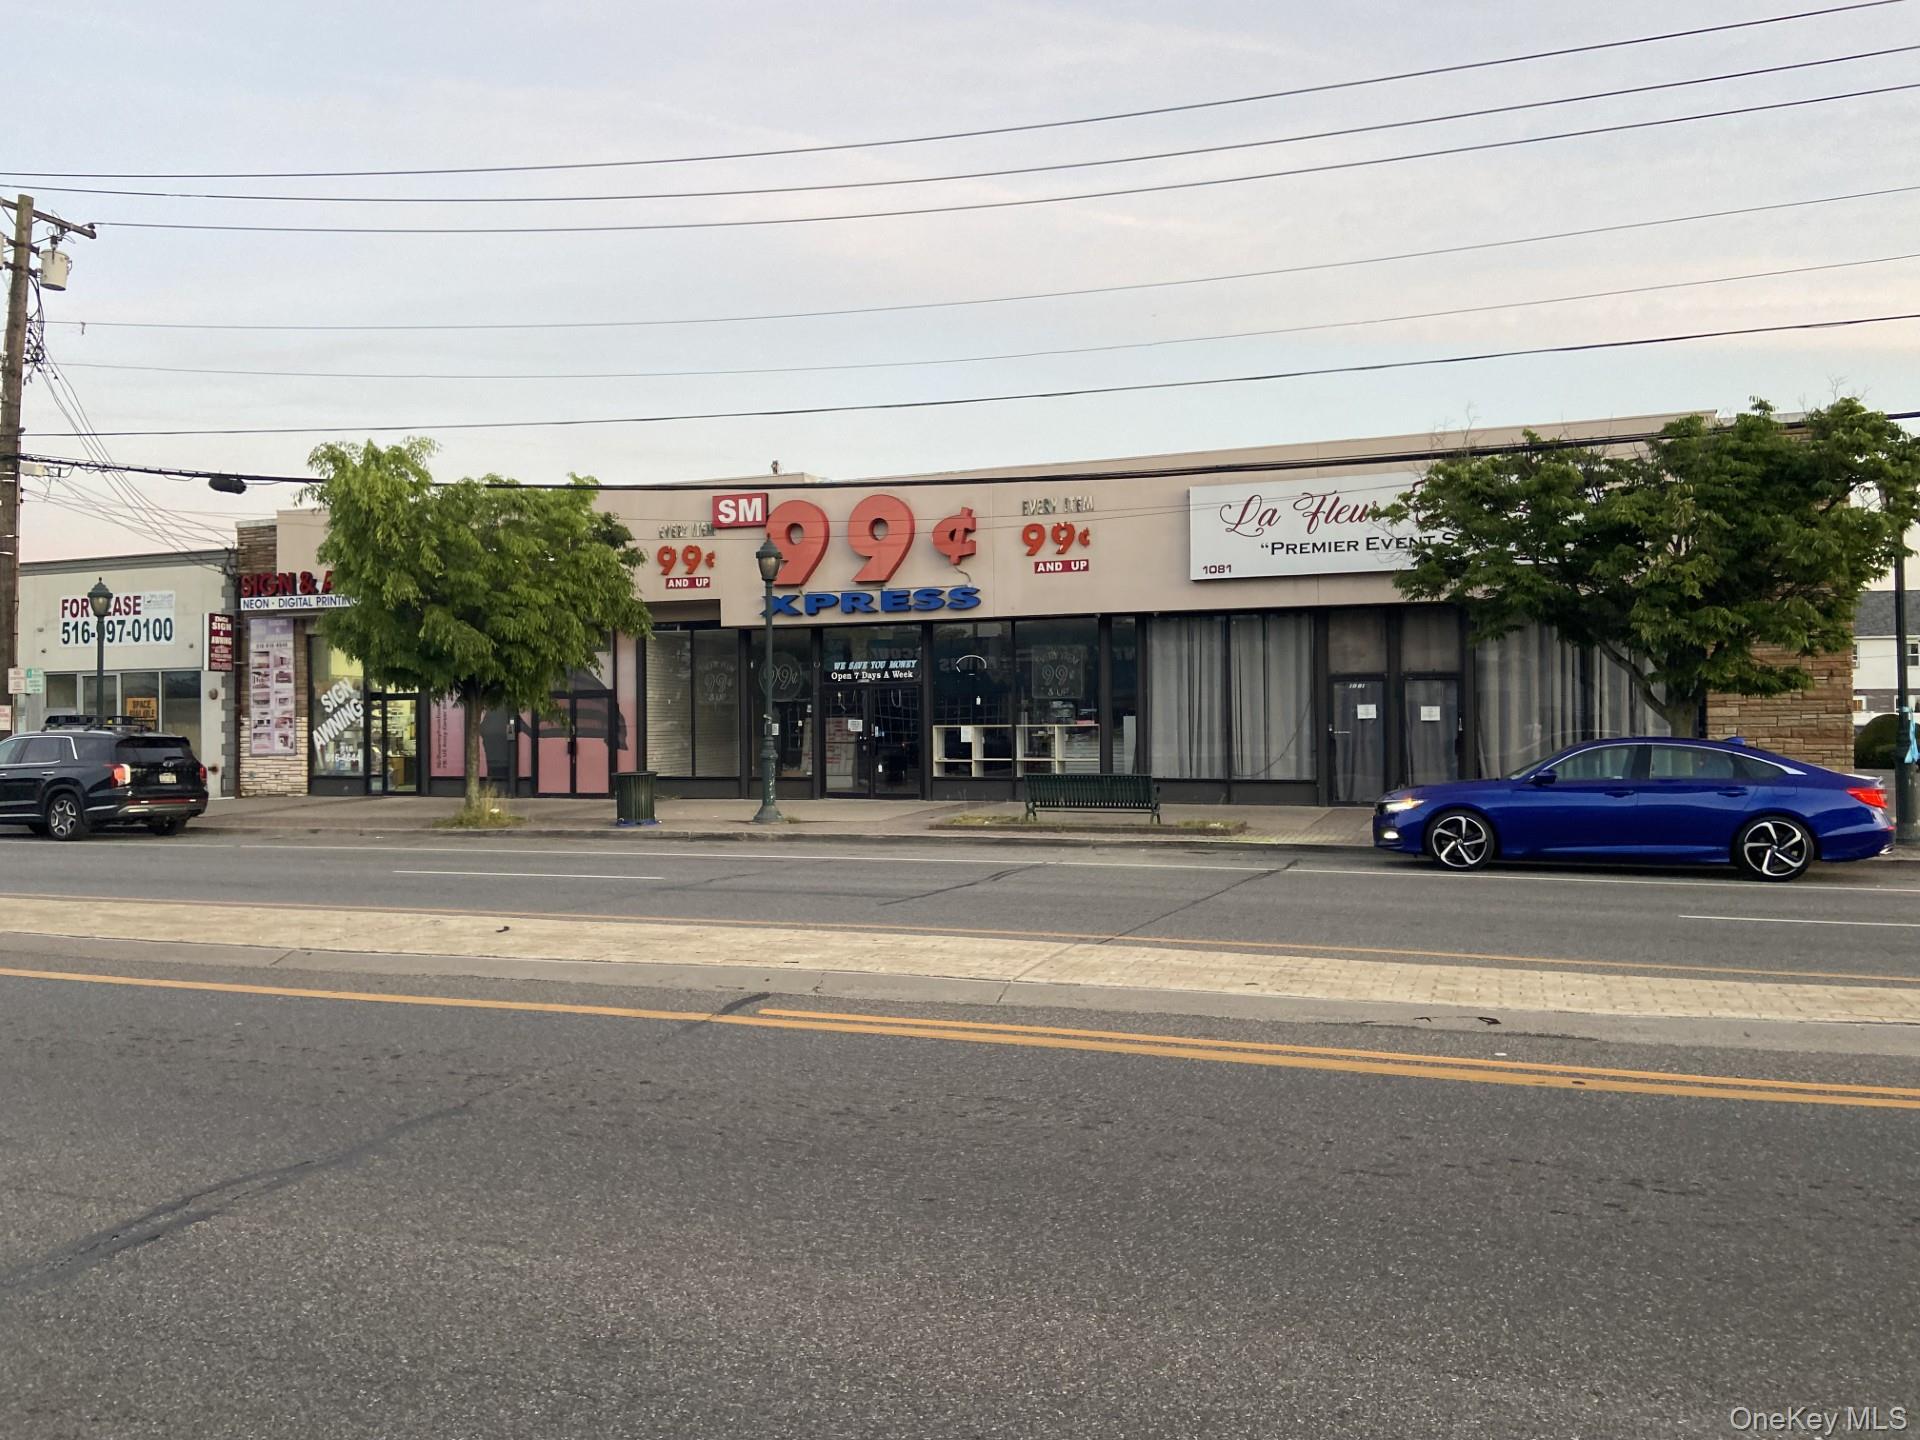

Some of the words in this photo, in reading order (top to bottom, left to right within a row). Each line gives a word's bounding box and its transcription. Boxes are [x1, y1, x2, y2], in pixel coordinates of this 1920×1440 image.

[717, 497, 762, 524] SM
[1022, 497, 1057, 516] EVERY
[1064, 495, 1094, 513] ITEM
[1219, 494, 1281, 538] La
[658, 524, 688, 539] EVERY
[691, 520, 716, 537] ITEM
[1037, 562, 1063, 572] AND
[1071, 560, 1087, 571] UP
[1202, 563, 1232, 575] 1081
[241, 572, 296, 598] SIGN
[300, 571, 318, 595] &
[667, 579, 689, 588] AND
[695, 578, 709, 587] UP
[61, 598, 89, 618] FOR
[243, 599, 269, 608] NEON
[278, 597, 312, 608] DIGITAL
[760, 587, 982, 618] XPRESS
[61, 617, 173, 645] 516-97-0100
[211, 622, 232, 631] SIGN
[834, 662, 846, 670] WE
[848, 661, 869, 670] SAVE
[871, 661, 886, 669] YOU
[889, 660, 917, 669] MONEY
[831, 671, 852, 681] Open
[854, 671, 860, 679] 7
[861, 671, 882, 680] Days
[884, 670, 890, 678] A
[892, 670, 913, 678] Week
[321, 677, 354, 713] SIGN
[312, 698, 364, 751] AWNING
